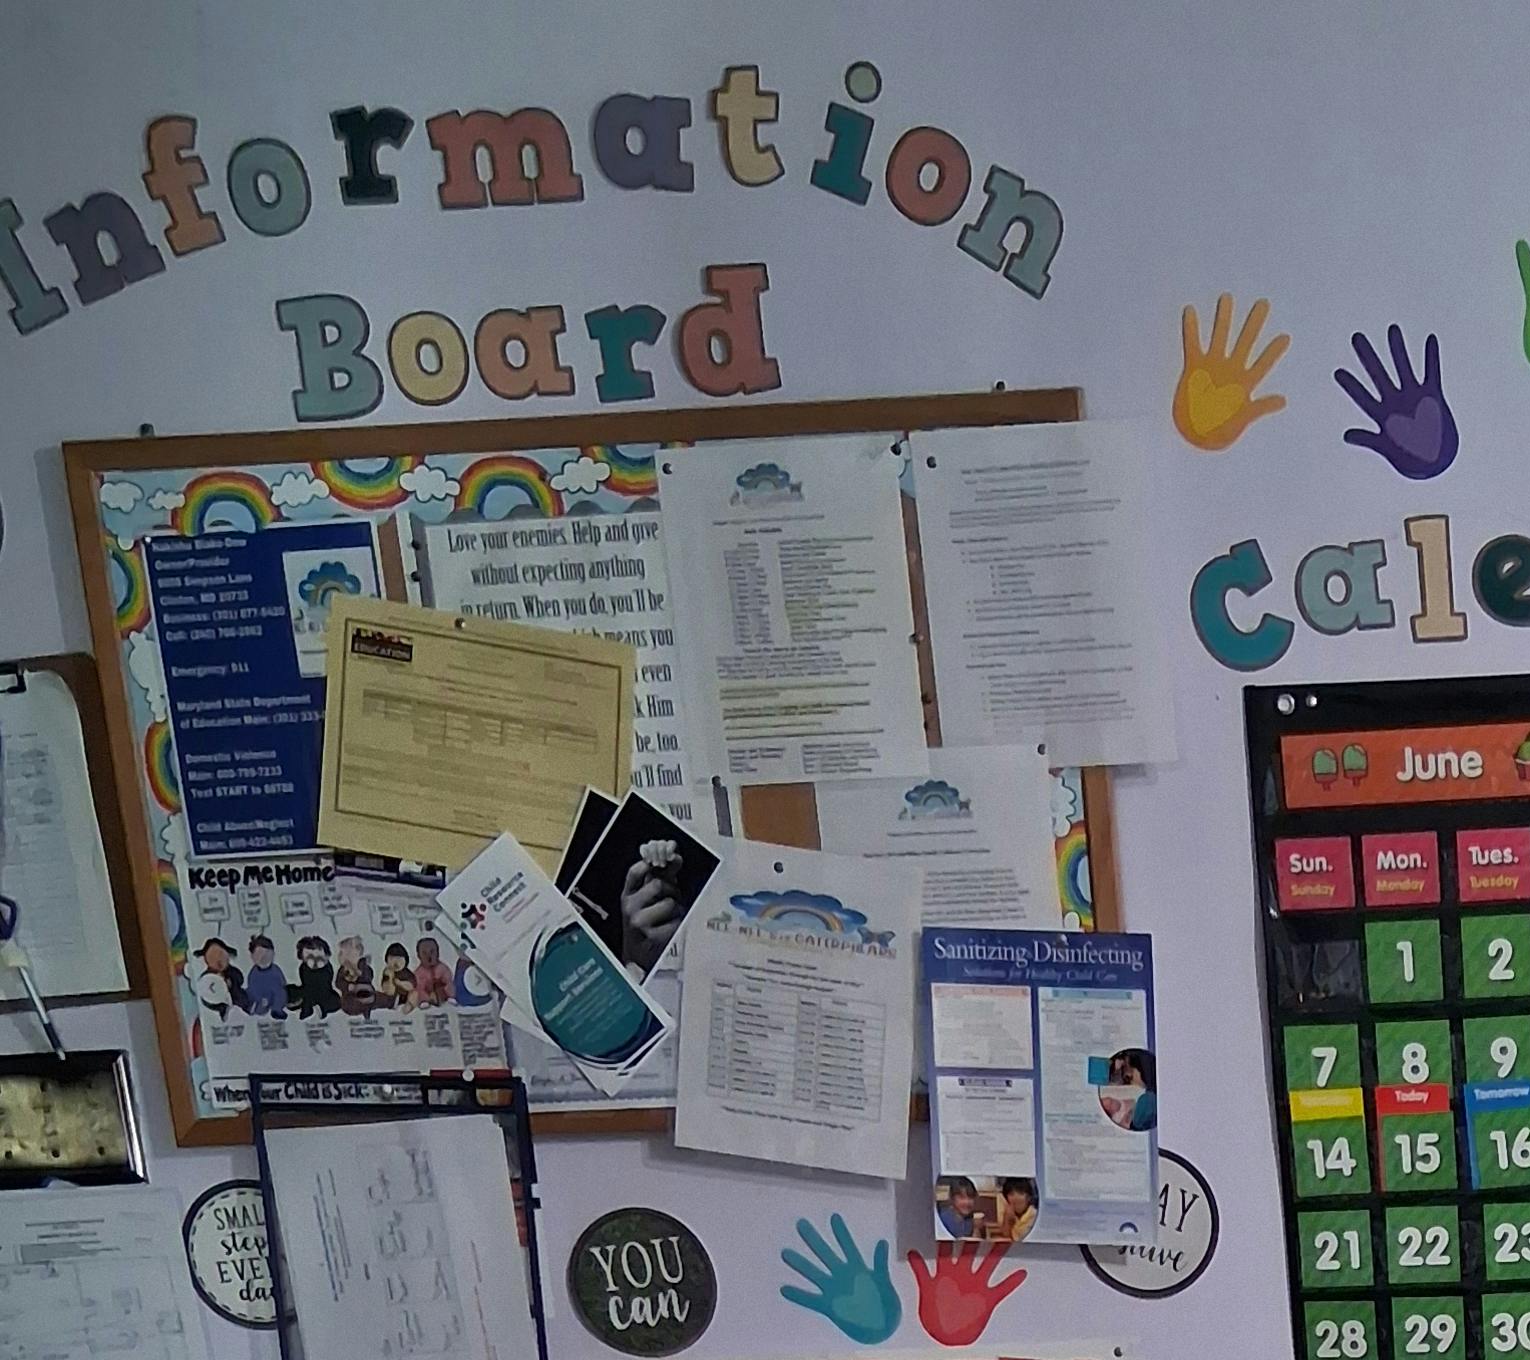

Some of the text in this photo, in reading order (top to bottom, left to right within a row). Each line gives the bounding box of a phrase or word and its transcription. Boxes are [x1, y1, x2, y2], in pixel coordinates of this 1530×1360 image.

[0, 60, 1064, 336] Information
[275, 262, 783, 421] Board
[447, 518, 659, 553] Love your enemies. Help and give
[471, 553, 646, 586] without expecting anything
[522, 594, 561, 619] When
[563, 597, 587, 621] you
[610, 589, 645, 617] you'll
[648, 590, 665, 611] be
[604, 630, 648, 647] means
[650, 628, 674, 650] you
[641, 663, 672, 683] even
[646, 693, 675, 718] Him
[656, 731, 681, 751] too.
[656, 763, 683, 787] find
[1396, 745, 1484, 782] June
[669, 803, 693, 821] you
[1289, 853, 1334, 873] Sun.
[1376, 850, 1428, 870] Mon.
[1467, 846, 1520, 865] Tues.
[188, 864, 336, 894] Keep Me Home
[1290, 884, 1335, 898] Sunday
[1376, 879, 1425, 894] Monday
[1469, 874, 1519, 890] Tuesday
[934, 937, 1144, 972] Sanitizing Disinfecting
[1396, 941, 1415, 982] 1
[1487, 938, 1515, 981] 2
[1311, 1047, 1338, 1087] 7
[1402, 1042, 1430, 1084] 8
[1490, 1037, 1518, 1079] 9
[214, 1081, 370, 1102] When our Child is Sick:
[1394, 1086, 1530, 1104] Today Tomorrow
[1307, 1137, 1356, 1180] 14
[1395, 1132, 1441, 1175] 15
[213, 1203, 265, 1231] SMAL
[1158, 1183, 1199, 1232] AY
[220, 1231, 267, 1258] step
[1314, 1230, 1361, 1271] 21
[1398, 1225, 1451, 1267] 22
[216, 1256, 266, 1283] EVE
[589, 1236, 683, 1292] YOU
[239, 1279, 271, 1302] da
[608, 1288, 690, 1331] can
[1314, 1319, 1368, 1360] 28
[1404, 1314, 1457, 1355] 29
